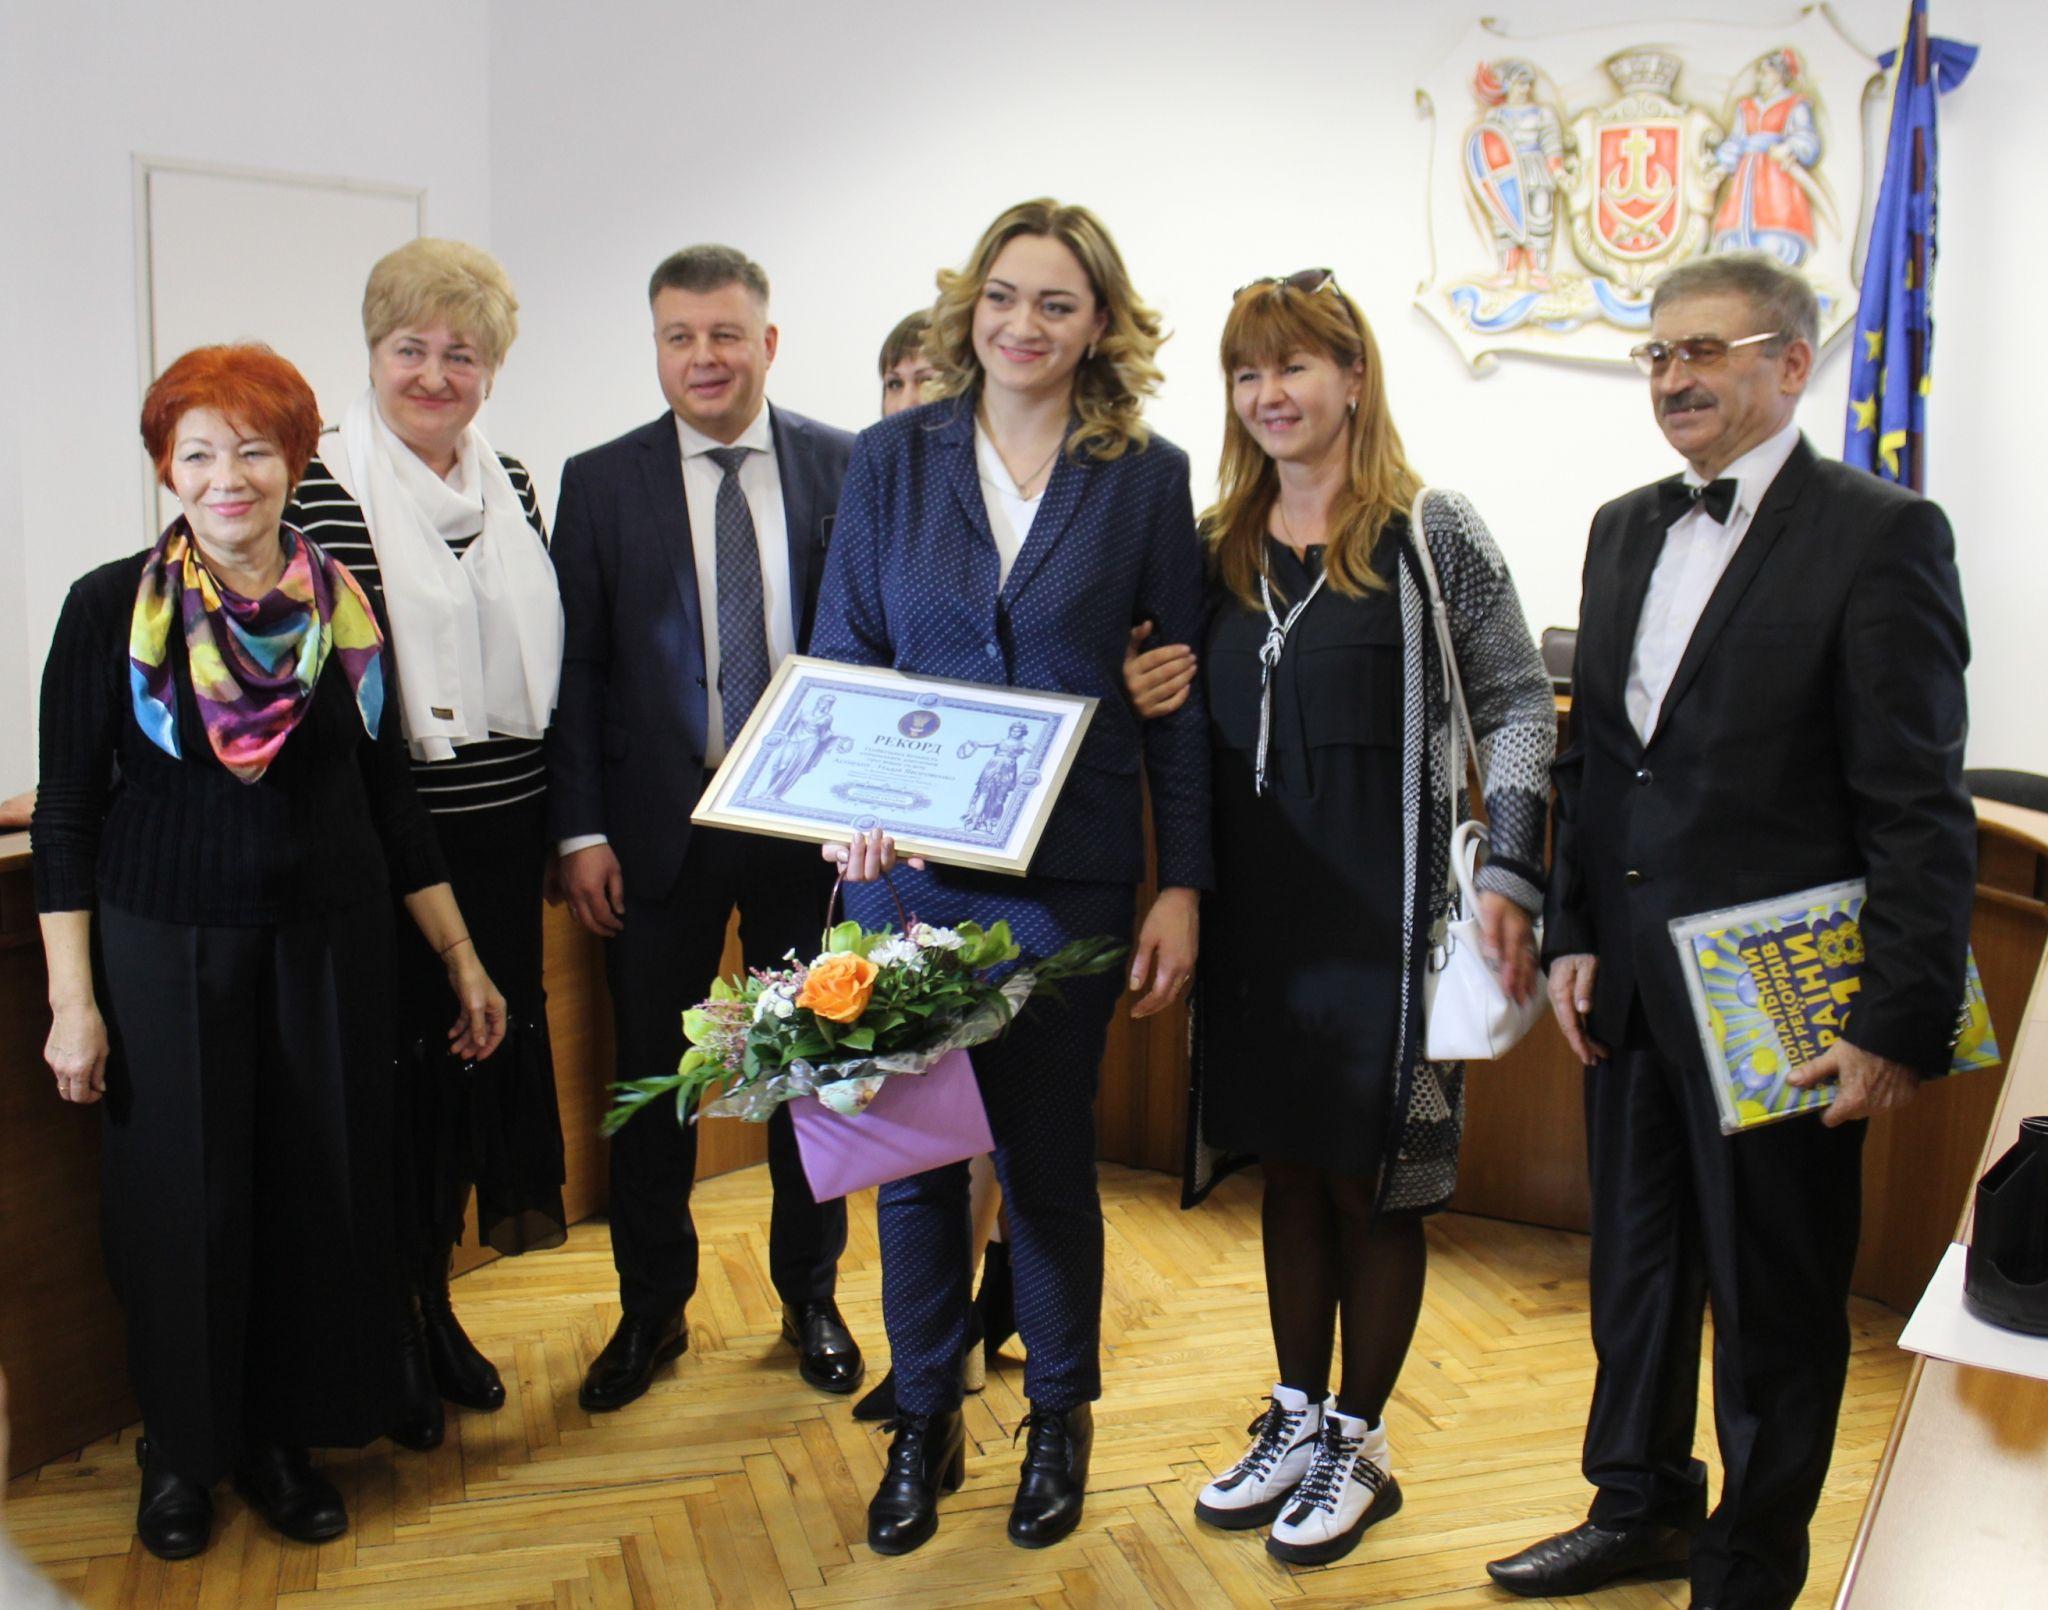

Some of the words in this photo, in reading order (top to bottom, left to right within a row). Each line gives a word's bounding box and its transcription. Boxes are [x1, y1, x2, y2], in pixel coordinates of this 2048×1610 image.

[873, 734, 943, 755] РЕКОРД
[1739, 947, 1803, 1069] ІОНАЛЬНИЙ
[1761, 941, 1810, 1037] РЕКОРДІВ
[1783, 932, 1843, 1048] РАЇНИ
[1816, 920, 1866, 1032] 18
